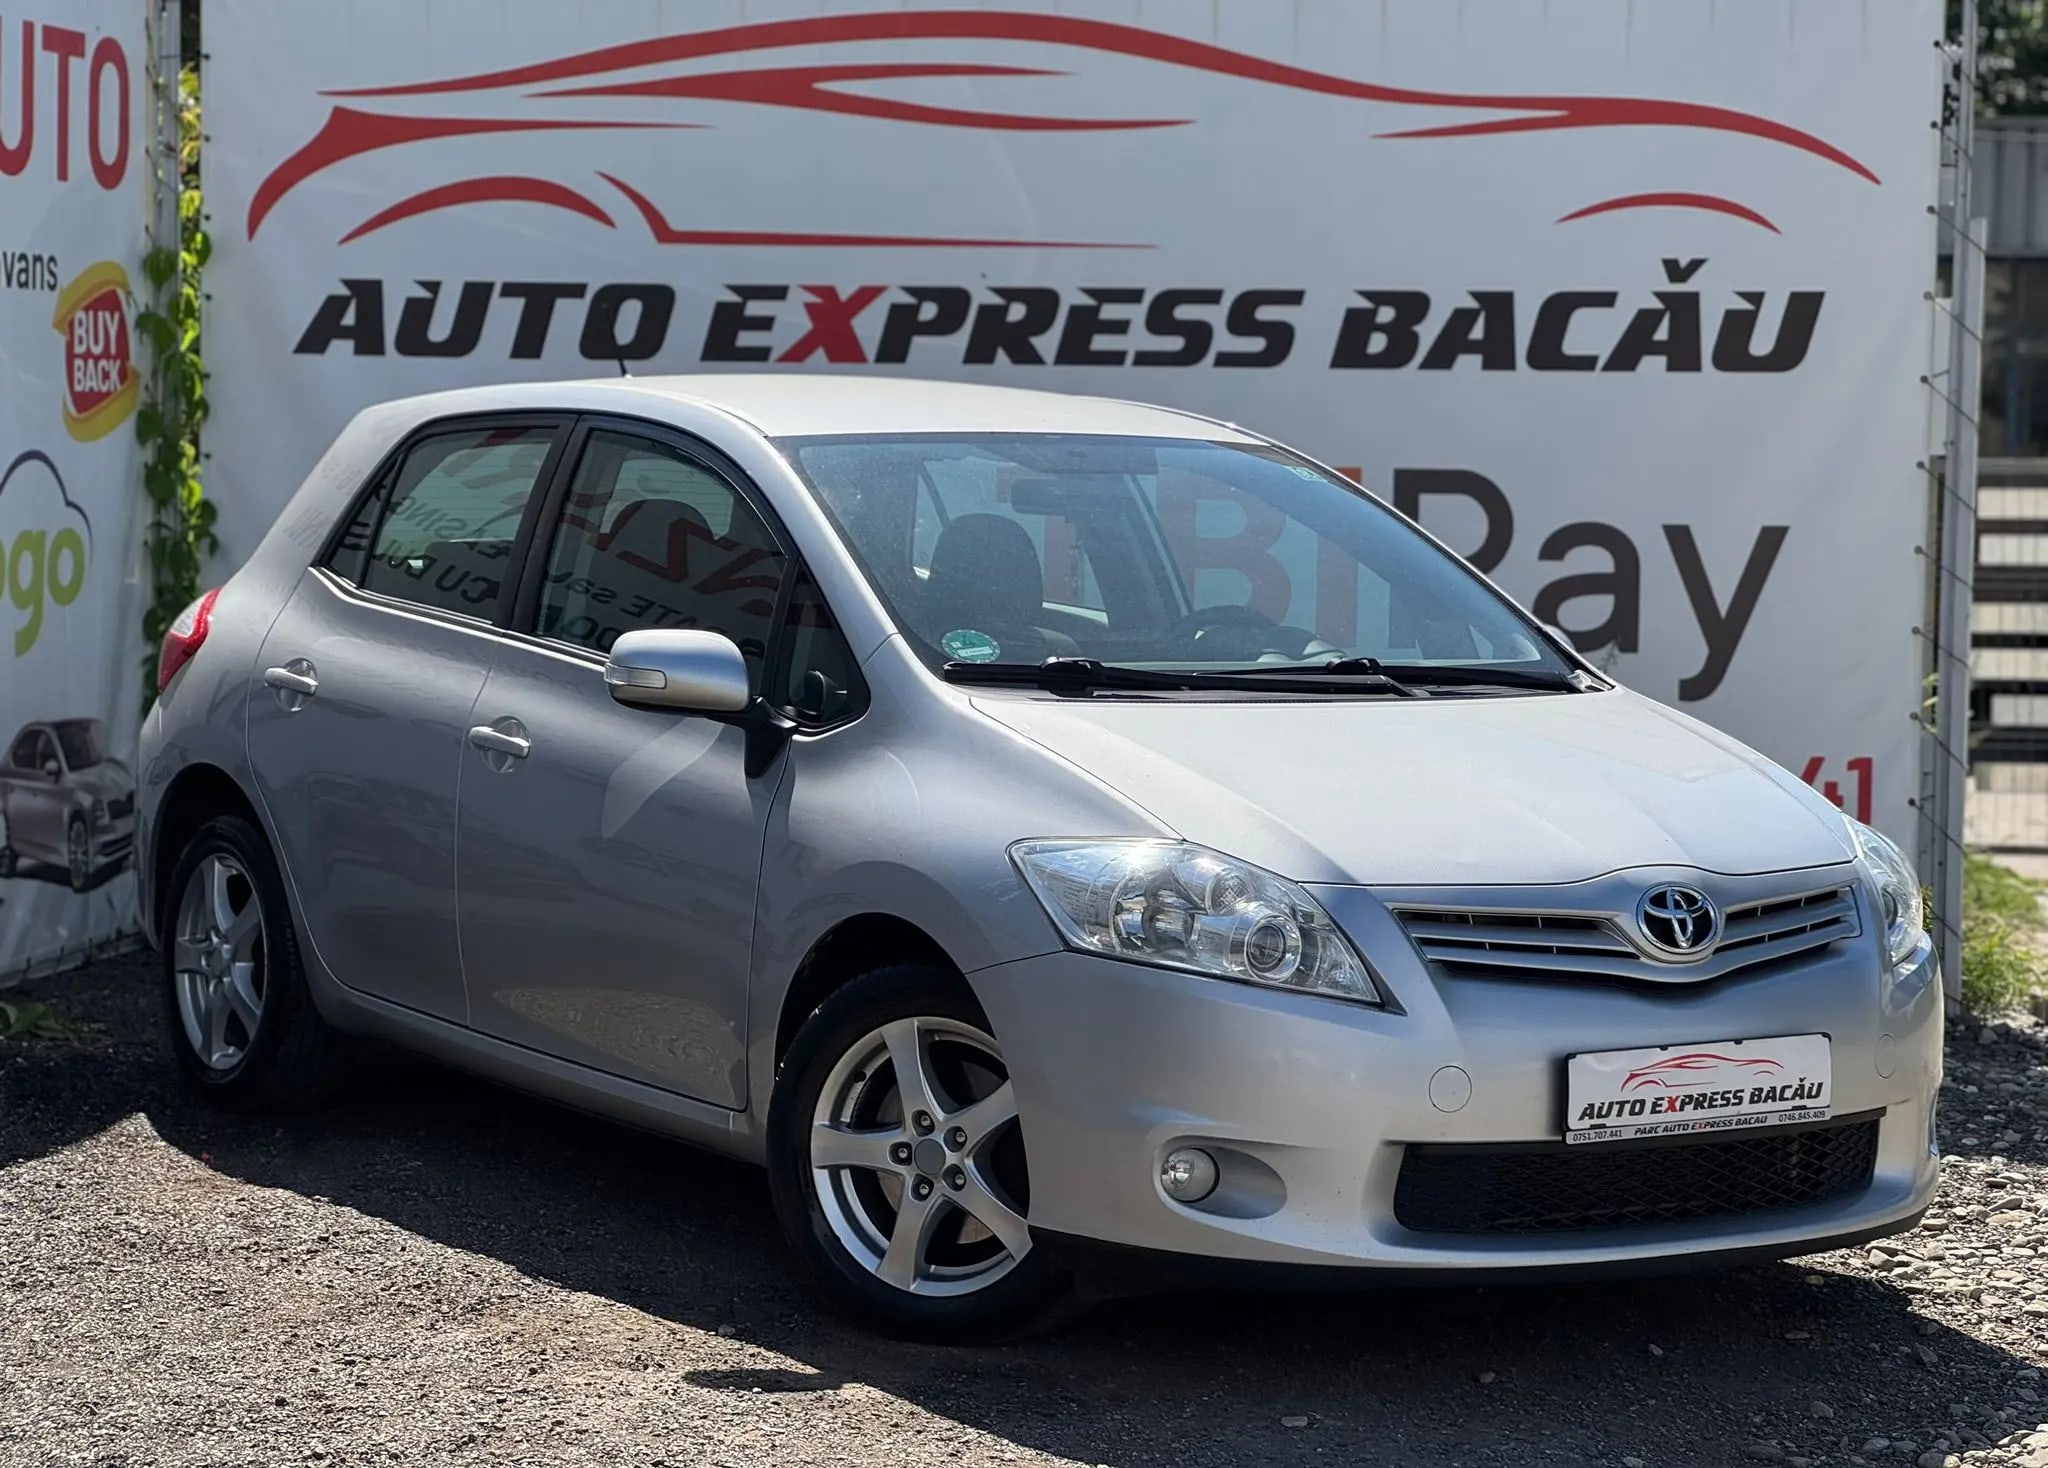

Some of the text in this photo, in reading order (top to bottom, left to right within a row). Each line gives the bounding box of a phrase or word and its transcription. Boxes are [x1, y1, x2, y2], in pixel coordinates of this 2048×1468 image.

[0, 251, 58, 292] vans
[73, 309, 121, 356] BUY
[292, 257, 1826, 373] AUTO EXPRESS BACĂU
[73, 357, 122, 393] BACK
[0, 527, 86, 659] go
[1577, 1076, 1824, 1121] AUTO EXPRESS BACĂU
[1633, 1125, 1660, 1136] PARC
[1661, 1121, 1690, 1133] AUTO
[1690, 1118, 1734, 1131] EXPRESS
